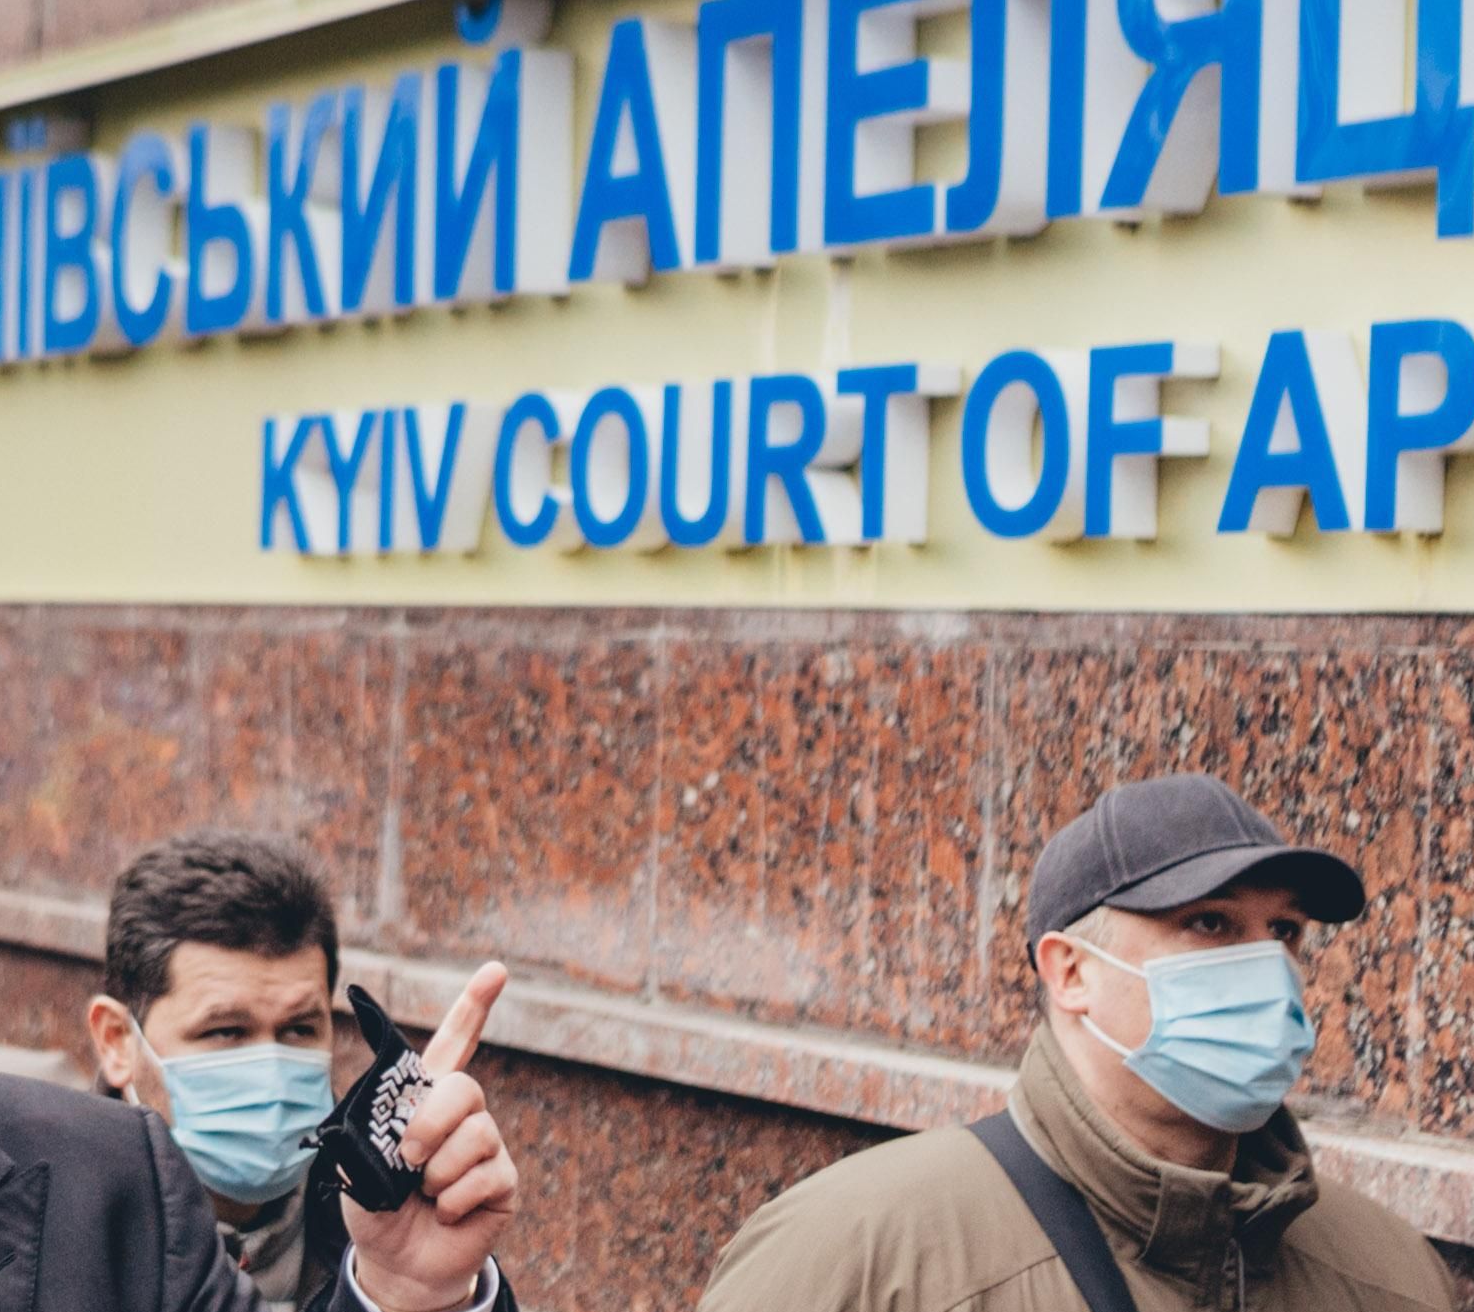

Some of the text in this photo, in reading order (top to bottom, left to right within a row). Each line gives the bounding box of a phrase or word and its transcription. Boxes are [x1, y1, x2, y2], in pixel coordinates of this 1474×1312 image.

[258, 401, 468, 553] KYIV
[491, 362, 921, 549] COURT
[959, 340, 1178, 540] OF
